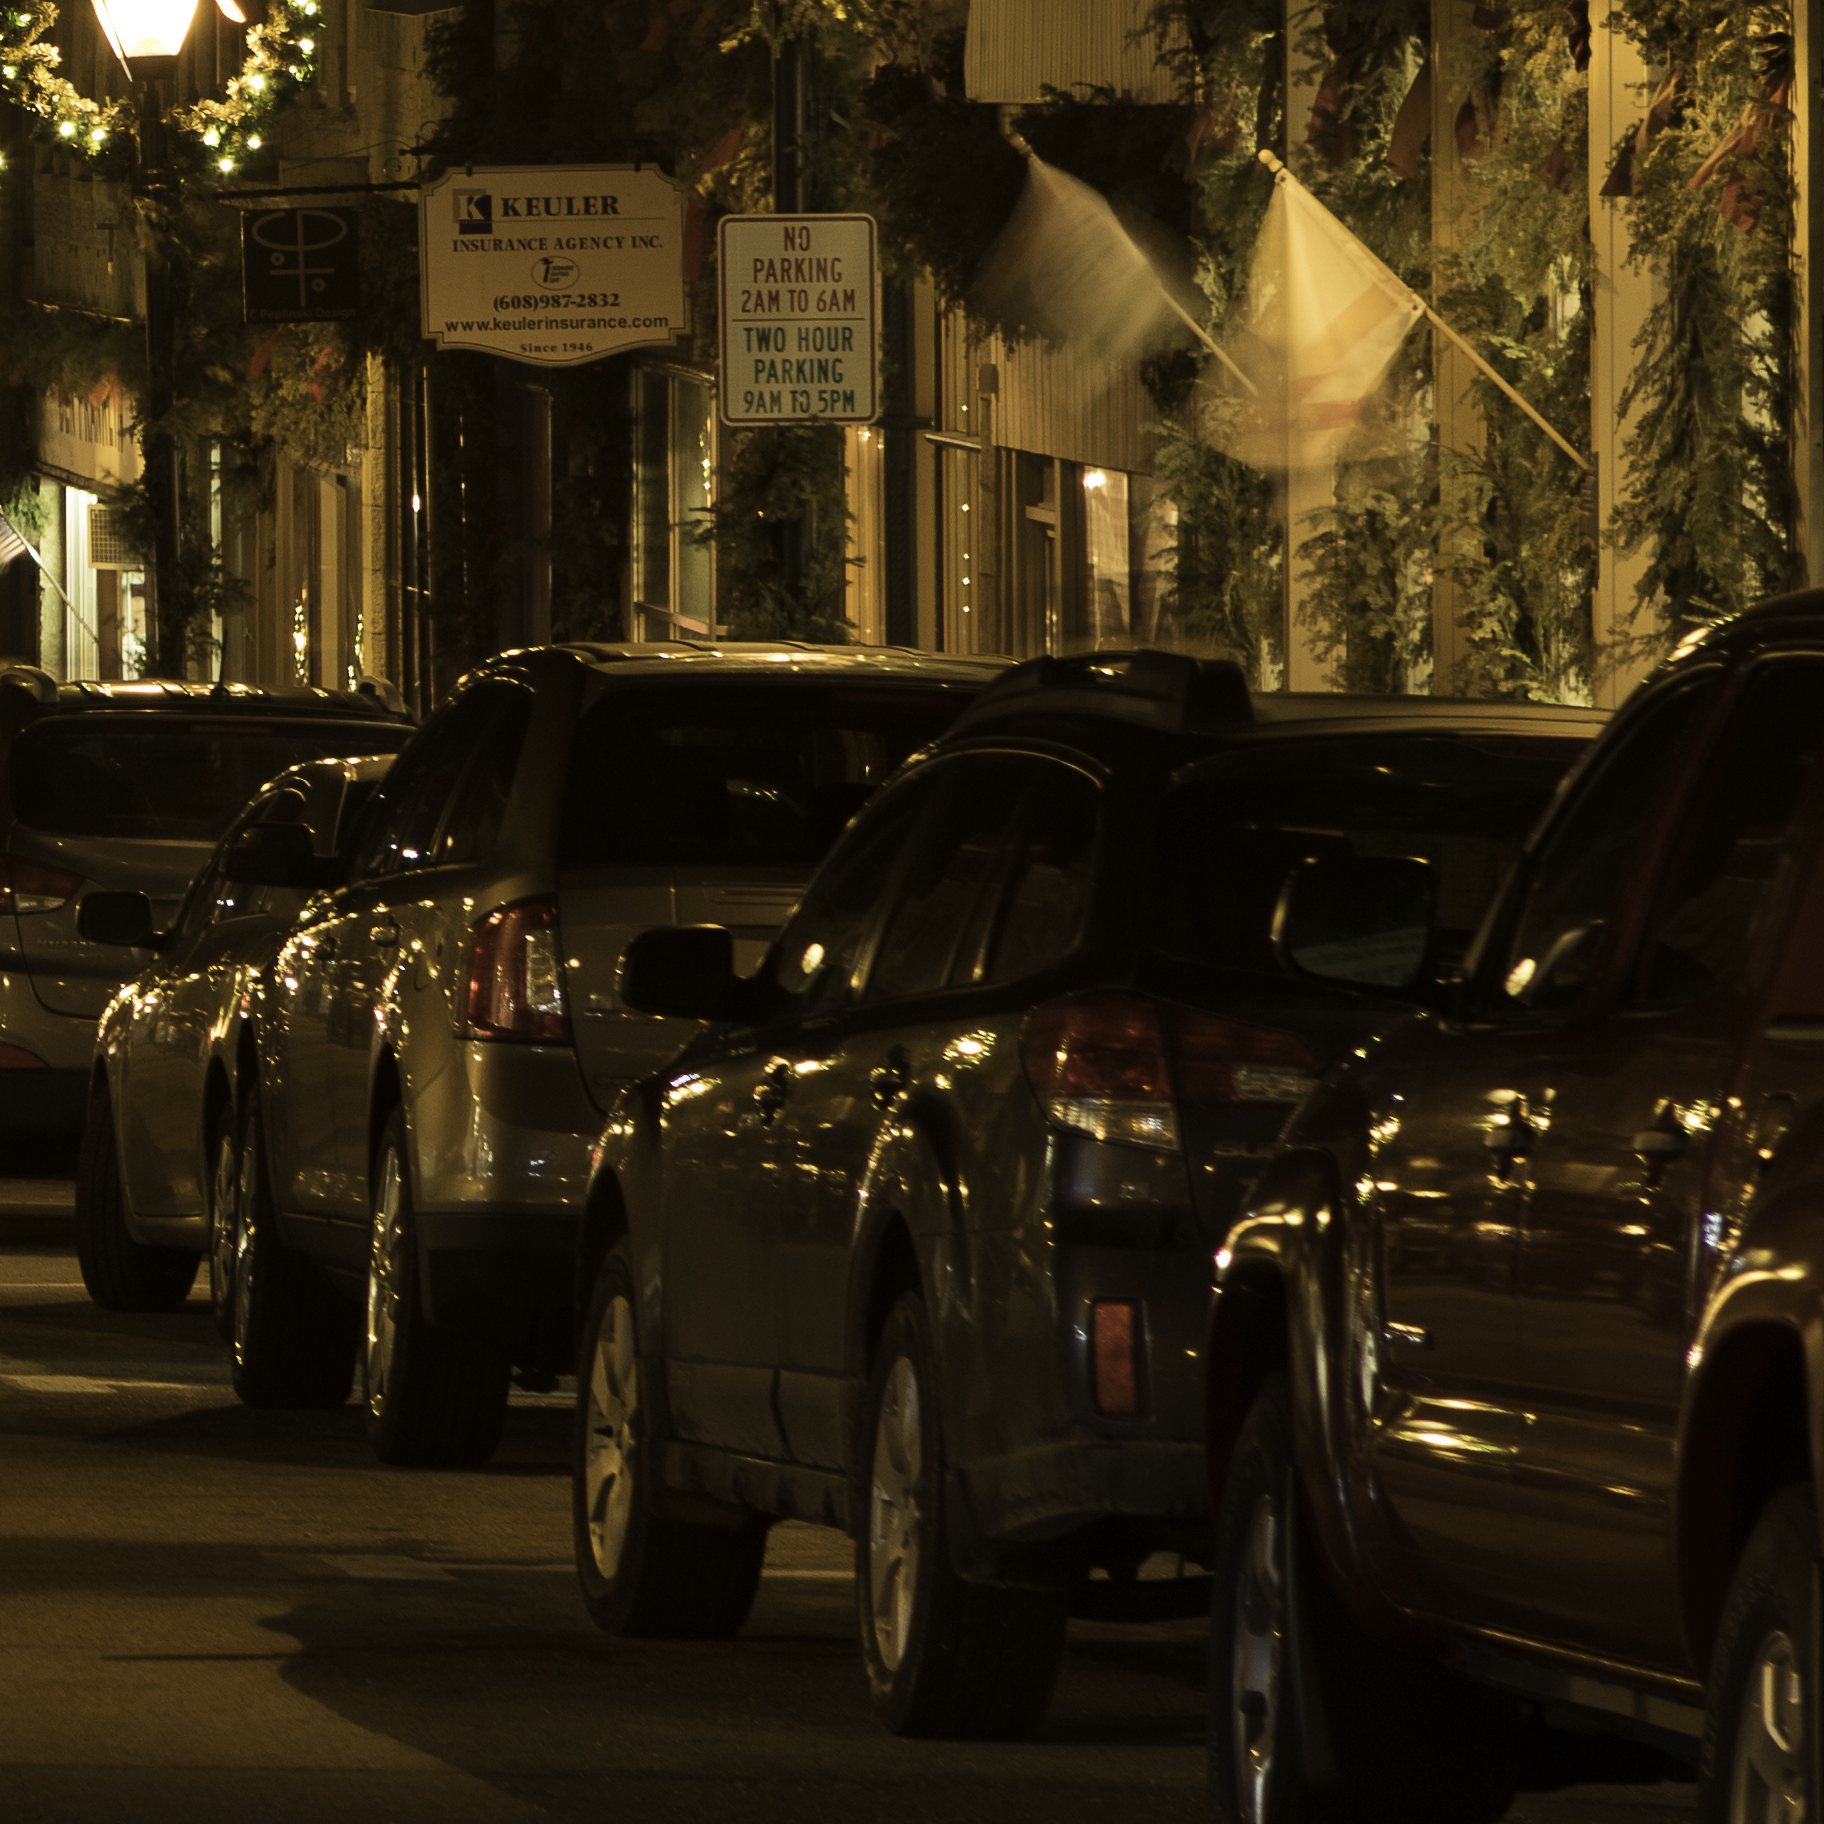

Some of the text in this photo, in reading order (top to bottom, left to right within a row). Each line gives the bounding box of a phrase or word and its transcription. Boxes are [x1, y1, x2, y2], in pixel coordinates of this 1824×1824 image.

[501, 195, 620, 217] KEULER
[452, 235, 664, 252] INSURANCE AGENCY INC.
[783, 225, 811, 252] NO
[753, 257, 843, 284] PARKING
[493, 292, 621, 313] (608)987-2832
[741, 288, 856, 313] 2AM TO 6AM
[315, 307, 356, 319] Design
[445, 316, 669, 333] www.keulerinsurance.com
[521, 342, 593, 353] Since 1946
[743, 326, 854, 353] TWO HOUR
[754, 357, 844, 384] PARKING
[743, 389, 855, 414] 9AM TO 5PM
